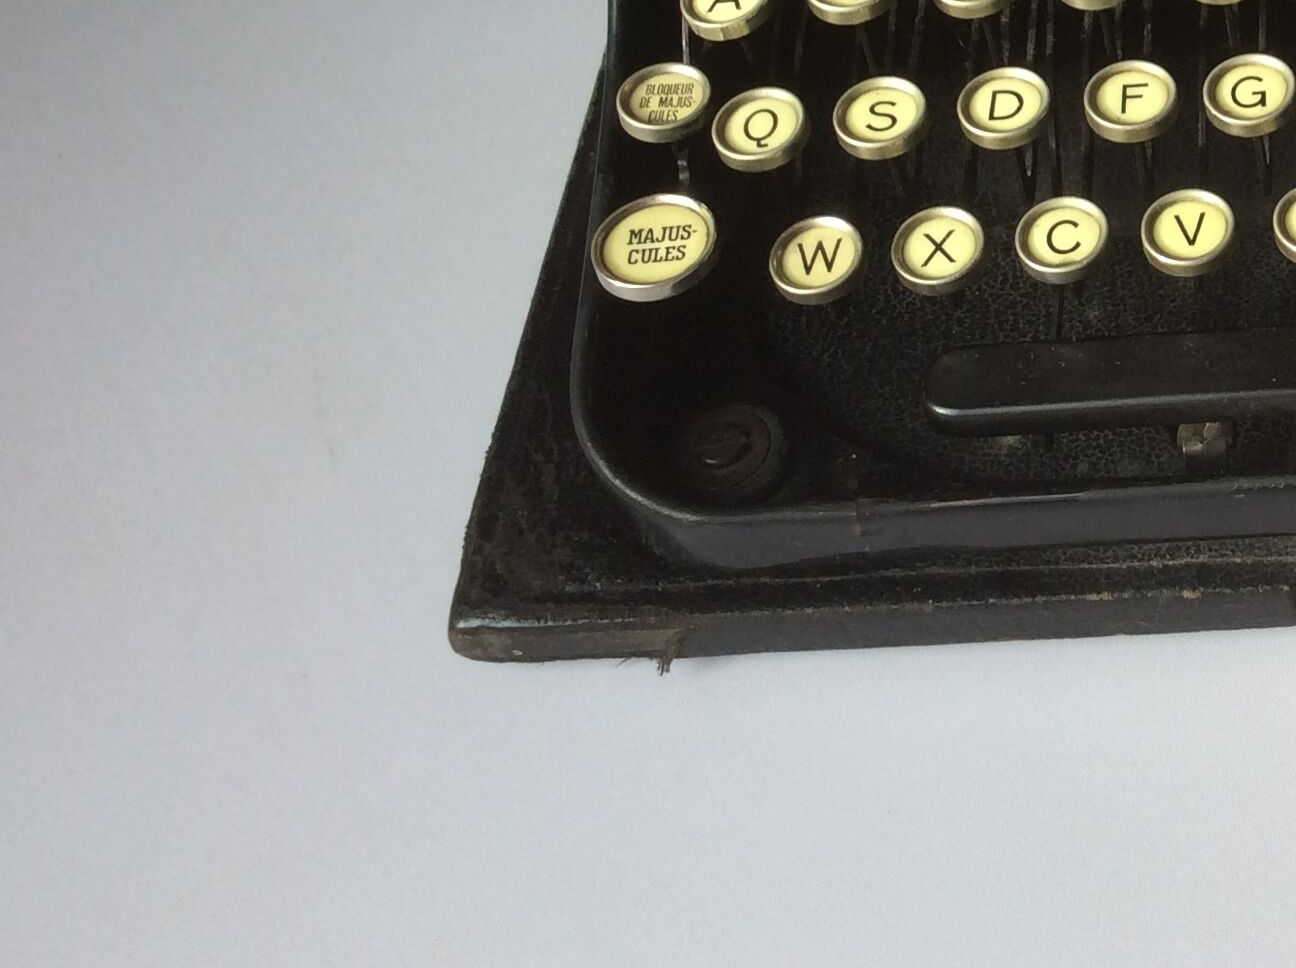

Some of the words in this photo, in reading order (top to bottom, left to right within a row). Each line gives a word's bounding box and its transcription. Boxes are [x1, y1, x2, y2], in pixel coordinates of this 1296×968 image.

[639, 96, 653, 109] DE
[658, 96, 696, 109] MAJUS-
[645, 83, 694, 96] BLOQUEUR
[988, 89, 1024, 121] D
[1120, 83, 1149, 114] F
[1230, 76, 1267, 108] G
[648, 109, 679, 123] CULES
[743, 109, 779, 148] Q
[865, 100, 897, 132] S
[626, 224, 698, 245] MAJUS-
[1046, 219, 1081, 254] C
[1174, 212, 1206, 246] V
[627, 244, 687, 265] CULES
[797, 237, 842, 275] W
[920, 229, 956, 267] X
